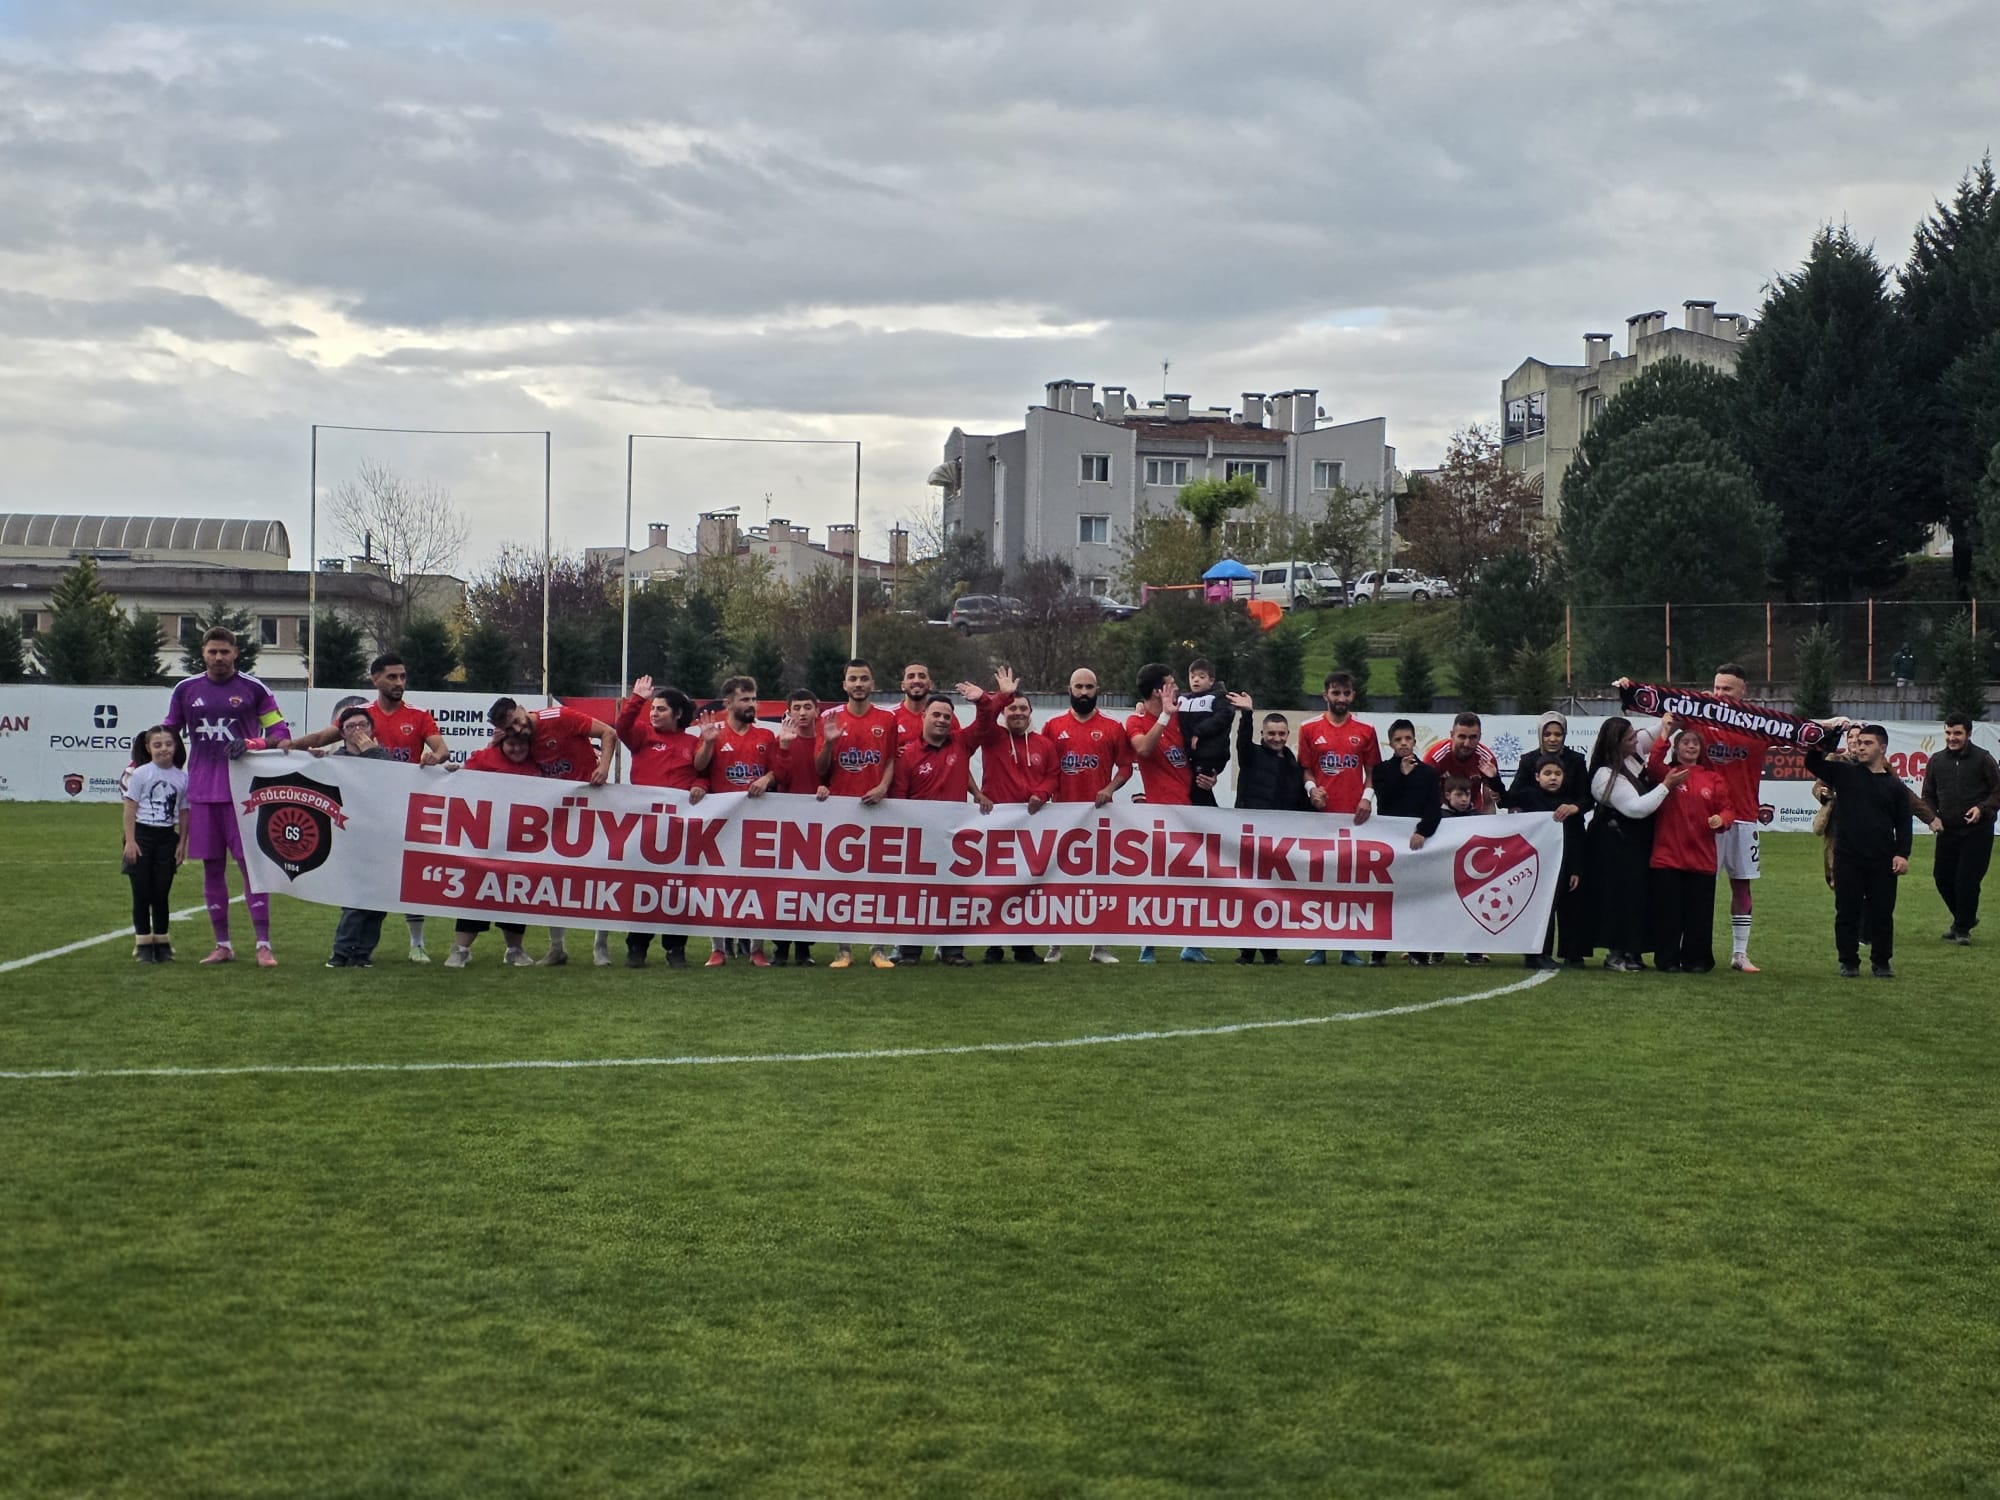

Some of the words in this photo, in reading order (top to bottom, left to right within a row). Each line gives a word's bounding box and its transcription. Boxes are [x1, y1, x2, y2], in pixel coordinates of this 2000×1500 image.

[0, 716, 29, 732] AN
[428, 709, 483, 723] LDIRIM
[1663, 695, 1794, 740] GÖLCÜKSPOR
[440, 725, 485, 737] ELEDİYE
[50, 736, 132, 749] POWERG
[259, 788, 330, 811] GÖLCÜKSPOR
[285, 826, 300, 841] GS
[404, 792, 493, 850] EN
[506, 796, 728, 868] BÜYÜK
[740, 819, 937, 876] ENGEL
[948, 817, 1394, 884] SEVGİSİZLİKTİR
[1506, 867, 1533, 886] 1923
[475, 871, 623, 912] ARALIK
[632, 878, 764, 920] DÜNYA
[776, 888, 992, 926] ENGELLİLER
[1000, 888, 1117, 927] GÜNÜ”
[1127, 896, 1243, 928] KUTLU
[1253, 899, 1374, 931] OLSUN
